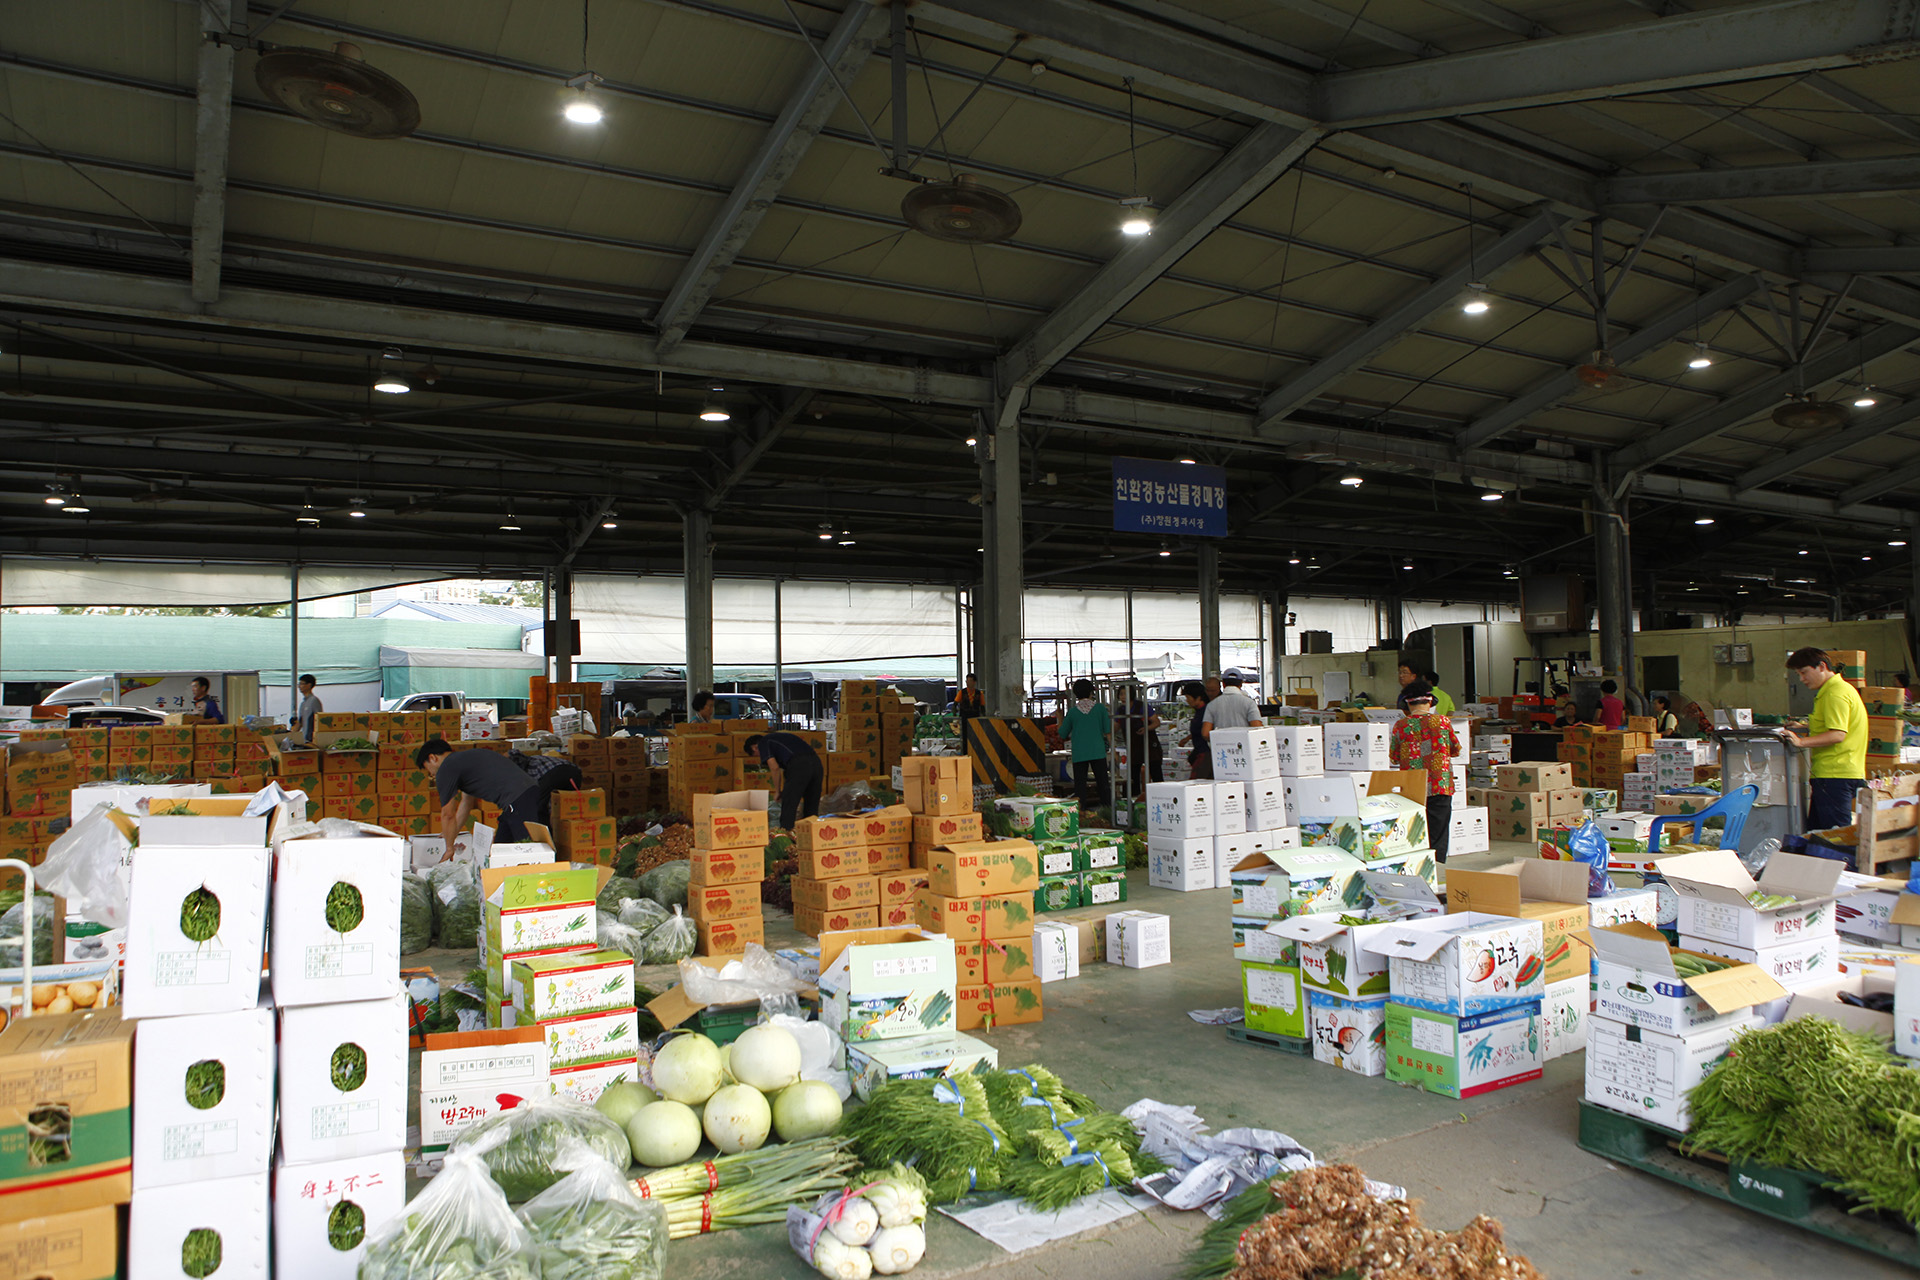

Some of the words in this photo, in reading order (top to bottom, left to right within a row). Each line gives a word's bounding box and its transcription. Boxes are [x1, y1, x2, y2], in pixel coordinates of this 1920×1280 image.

[1116, 477, 1225, 510] 친환경농산물경매장
[1330, 739, 1343, 759] 清
[1348, 748, 1364, 758] 부추
[1217, 748, 1227, 769] 清
[1233, 757, 1247, 768] 부추
[1151, 803, 1163, 824] 清
[1167, 813, 1181, 824] 부추
[958, 855, 977, 868] 대저
[1152, 855, 1163, 876] 清
[1168, 865, 1181, 877] 부추
[948, 901, 968, 912] 대저
[1868, 903, 1889, 918] 밀양
[1495, 942, 1519, 968] 고추
[959, 989, 979, 1000] 대저
[440, 1105, 488, 1126] 밤고구마
[300, 1172, 384, 1199] 身土不二
